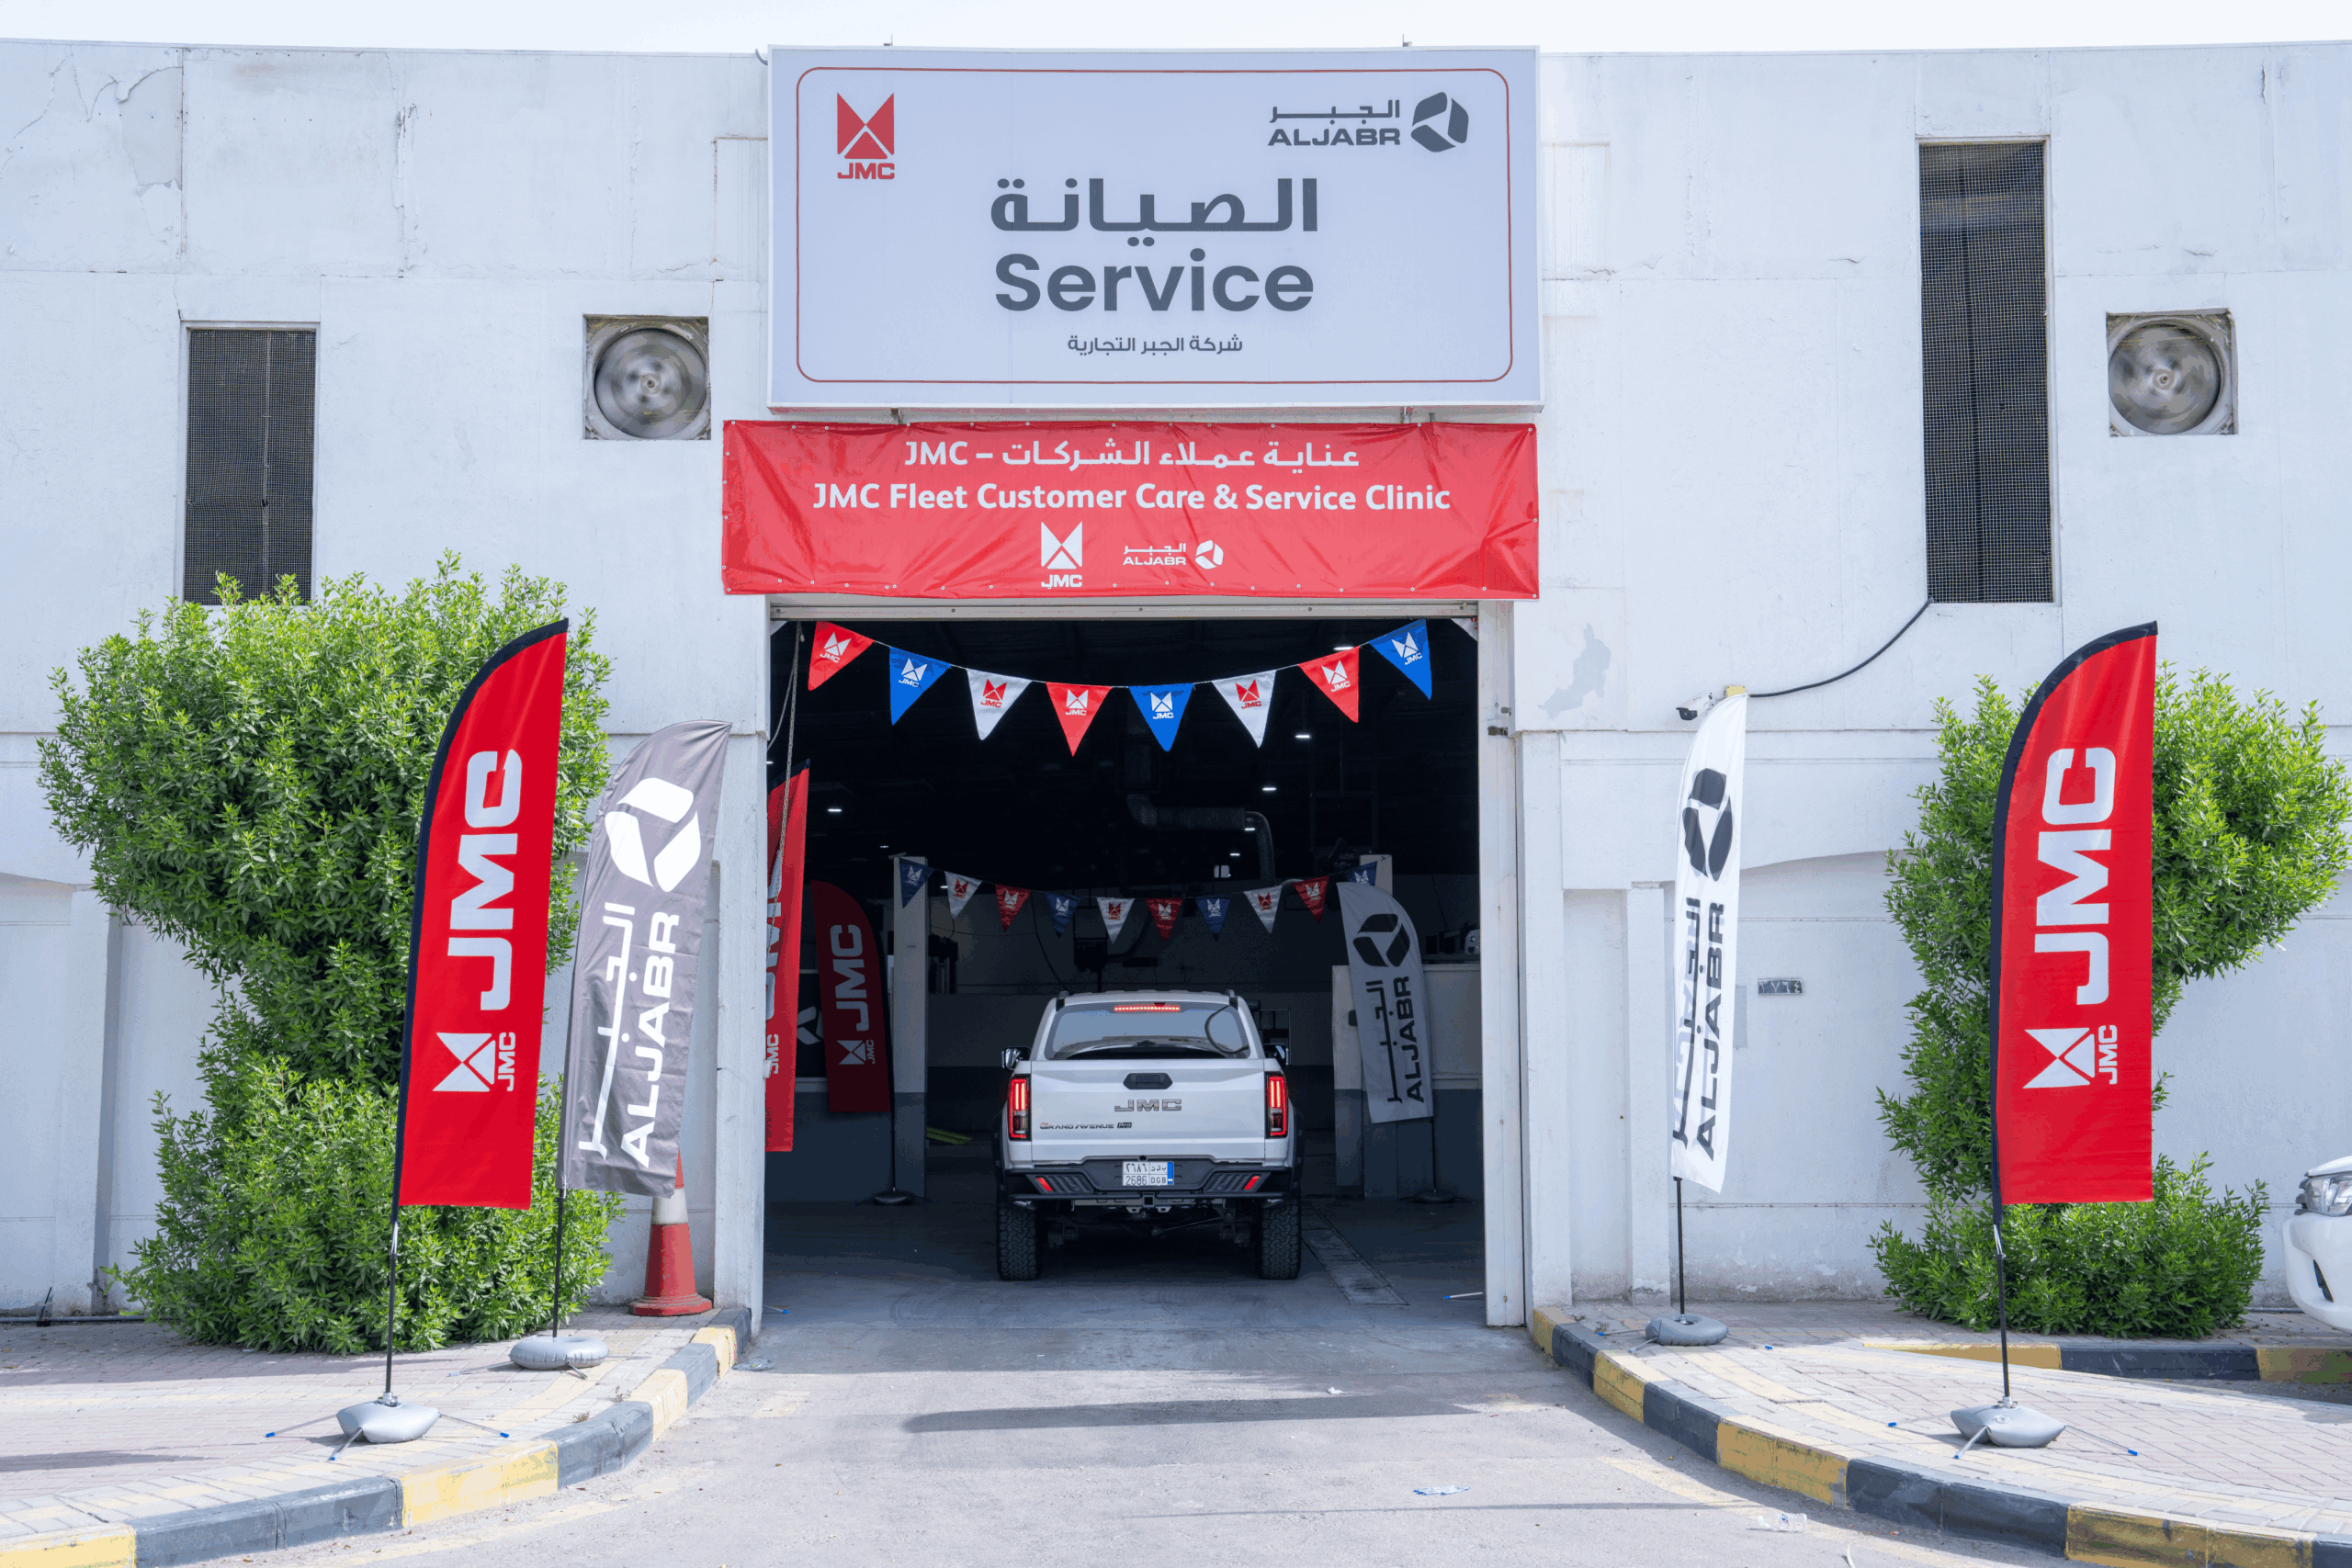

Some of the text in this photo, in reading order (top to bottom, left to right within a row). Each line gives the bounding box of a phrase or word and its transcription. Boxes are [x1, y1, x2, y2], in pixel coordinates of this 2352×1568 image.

[1269, 99, 1400, 125] الجبر
[1267, 128, 1401, 146] ALJABR
[837, 163, 895, 179] JMC
[990, 177, 1318, 247] الصيانة
[995, 248, 1314, 312] Service
[1067, 333, 1243, 356] شركة الجبر التجارية
[905, 441, 968, 466] JMC
[1001, 438, 1150, 472] الشركات
[1159, 441, 1256, 469] عملاء
[1262, 441, 1360, 474] عناية
[812, 482, 1451, 511] JMC Fleet Customer Care & Service Clinic
[1122, 556, 1187, 566] ALJABR
[1123, 543, 1186, 556] الجبر
[1040, 575, 1083, 588] JMC
[820, 651, 841, 663] JMC
[1403, 651, 1423, 666] JMC
[898, 678, 920, 688] JMC
[1330, 680, 1351, 693] JMC
[980, 699, 1002, 709] JMC
[1065, 708, 1088, 716] JMC
[1152, 711, 1175, 720] JMC
[1240, 701, 1262, 710] JMC
[447, 749, 523, 1011] JMC
[2034, 747, 2117, 1005] JMC
[830, 924, 870, 1032] JMC
[620, 911, 680, 1169] ALJABR
[1393, 976, 1425, 1103] ALJABR
[1696, 902, 1724, 1162] ALJABR
[498, 1032, 516, 1092] JMC
[865, 1039, 876, 1065] JMC
[2098, 1024, 2118, 1085] JMC
[1114, 1099, 1182, 1111] JMC
[1125, 1175, 1148, 1185] 2686
